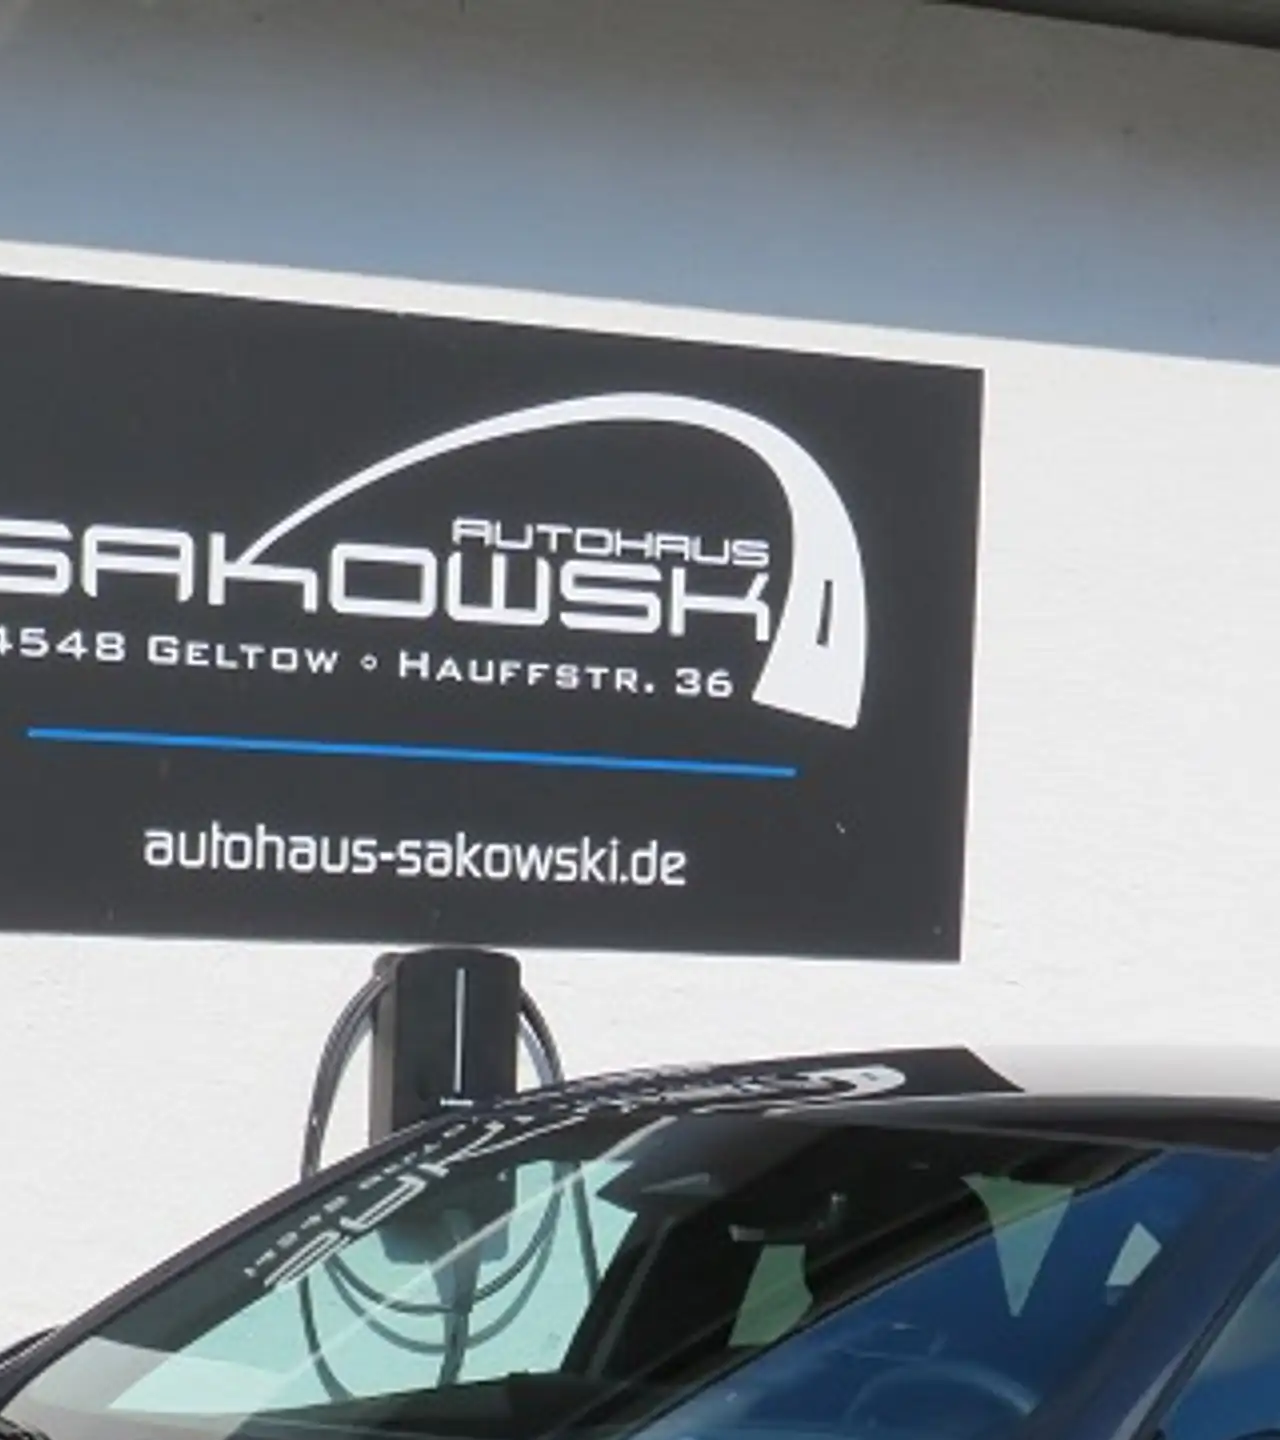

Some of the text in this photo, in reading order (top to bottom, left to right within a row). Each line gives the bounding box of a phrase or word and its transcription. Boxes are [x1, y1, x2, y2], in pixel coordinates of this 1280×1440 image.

[451, 517, 770, 568] AUTOHAUS
[147, 634, 340, 674] GELTOW
[398, 650, 656, 695] HAUFFSTR.
[675, 666, 734, 698] 36
[143, 821, 688, 887] autohaus-sakowski.de
